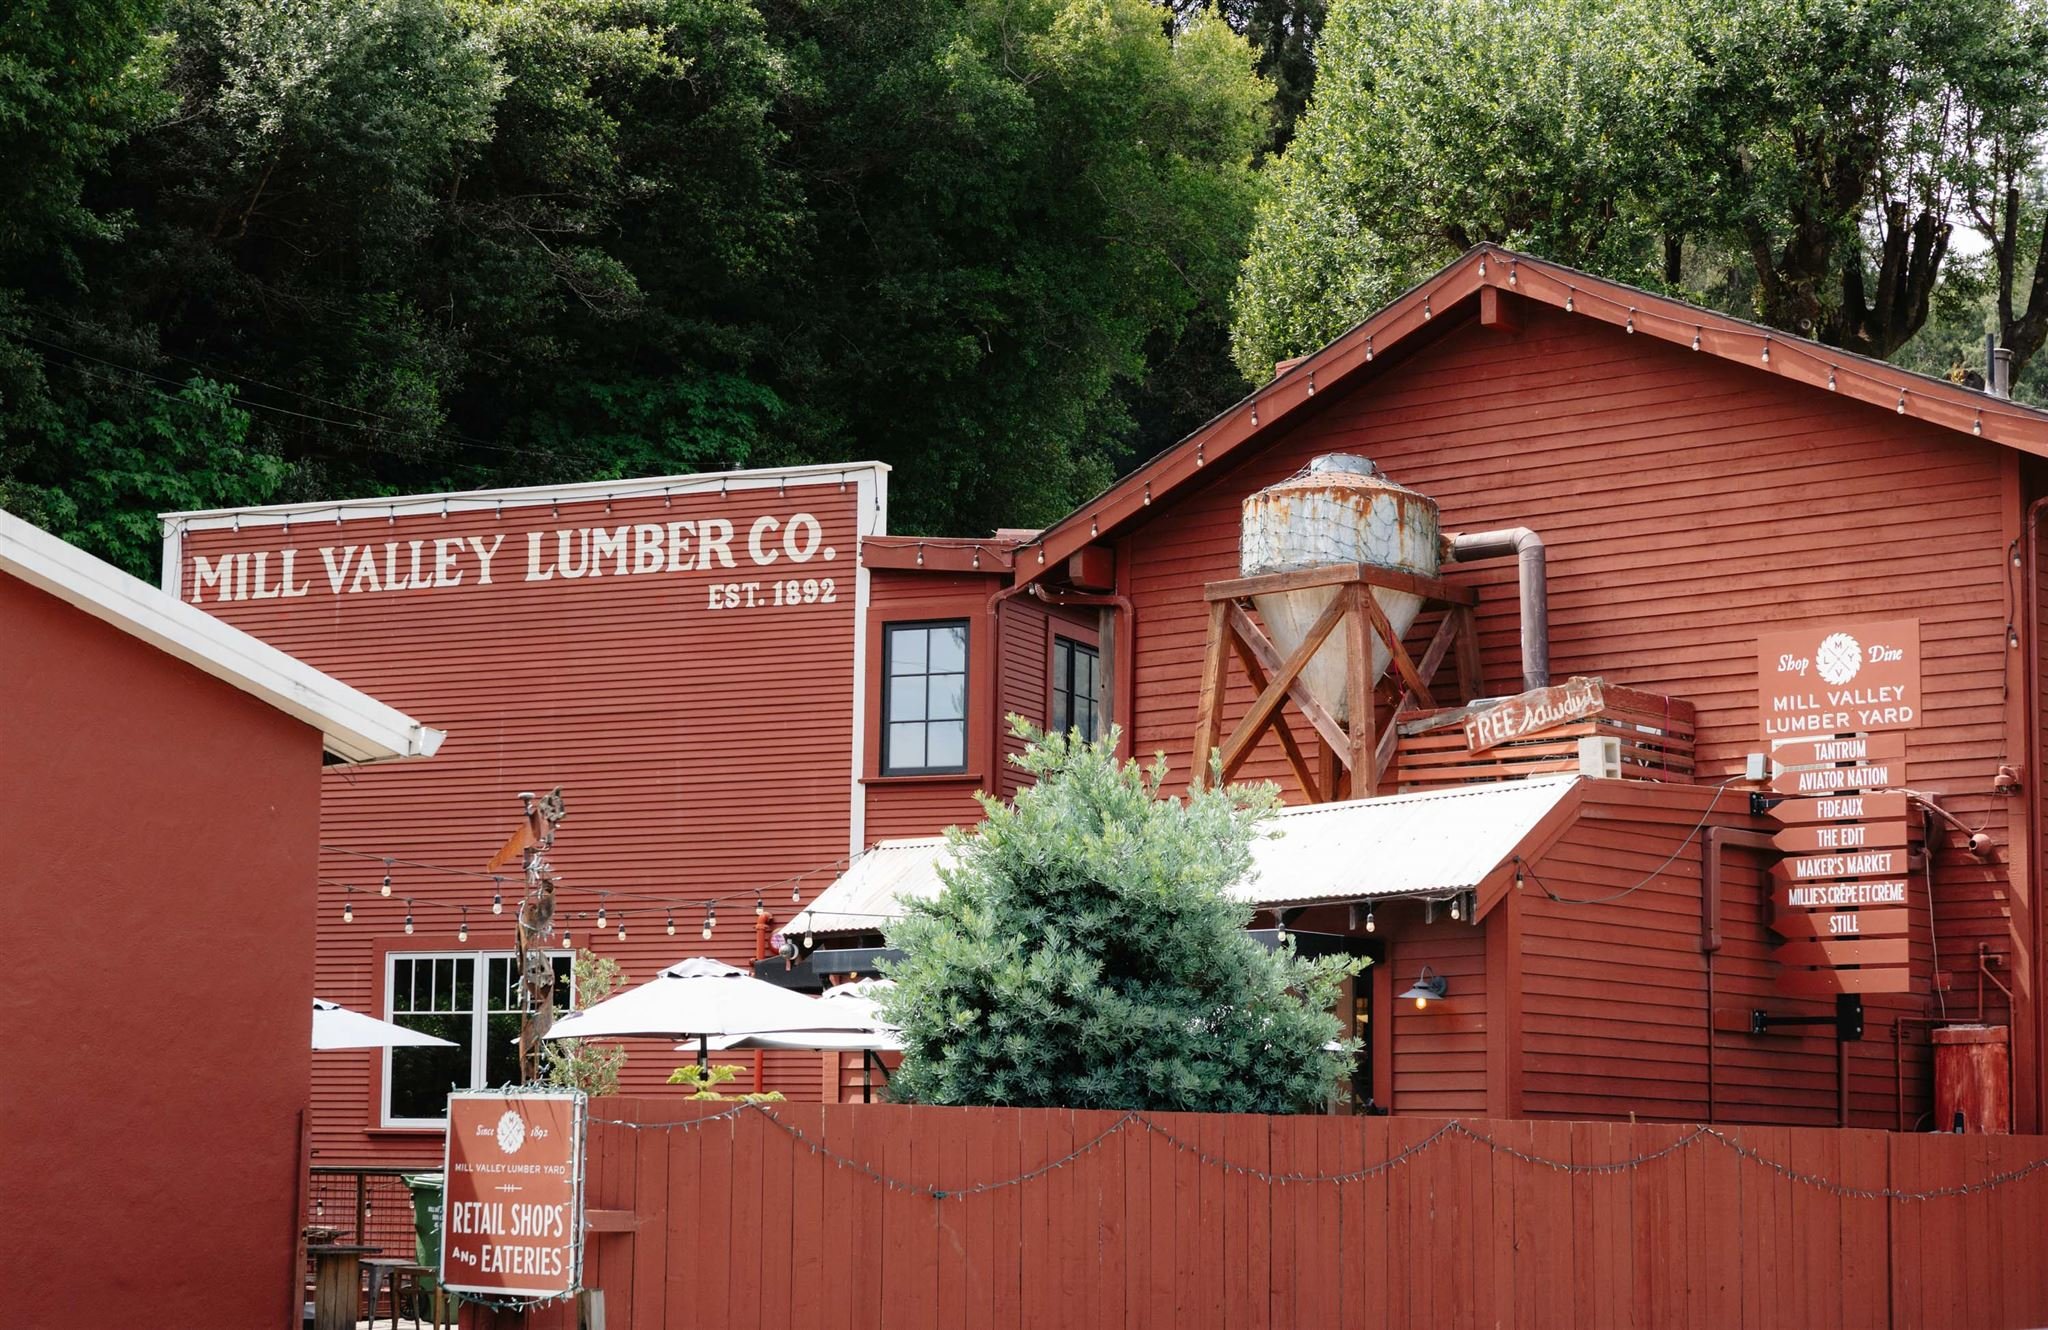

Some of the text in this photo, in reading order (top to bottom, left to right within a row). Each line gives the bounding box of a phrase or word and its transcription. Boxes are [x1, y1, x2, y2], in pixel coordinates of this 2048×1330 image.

[191, 513, 836, 601] MILL VALLEY LUMBER CO.
[707, 577, 836, 610] EST. 1892
[1778, 654, 1809, 676] Shop
[1868, 645, 1903, 662] Dine
[1773, 685, 1904, 711] MILL VALLEY
[1465, 707, 1516, 749] FREE
[1766, 707, 1913, 733] LUMBER YARD
[1814, 741, 1866, 760] TANTRUM
[1799, 767, 1887, 791] AVIATOR NATION
[1817, 798, 1863, 818] FIDEAUX
[1817, 827, 1865, 847] THE EDIT
[1797, 853, 1892, 877] MAKER'S MARKET
[1789, 882, 1904, 905] MILLIE'S CRÊPE ET CRÈME
[1830, 915, 1859, 933] STILL
[476, 1125, 494, 1136] Since
[530, 1126, 549, 1138] 1892
[455, 1163, 565, 1175] MILL VALLEY LUMBER YARD
[453, 1201, 505, 1236] RETAIL
[511, 1203, 563, 1238] SHOPS
[452, 1244, 562, 1276] AND EATERIES
